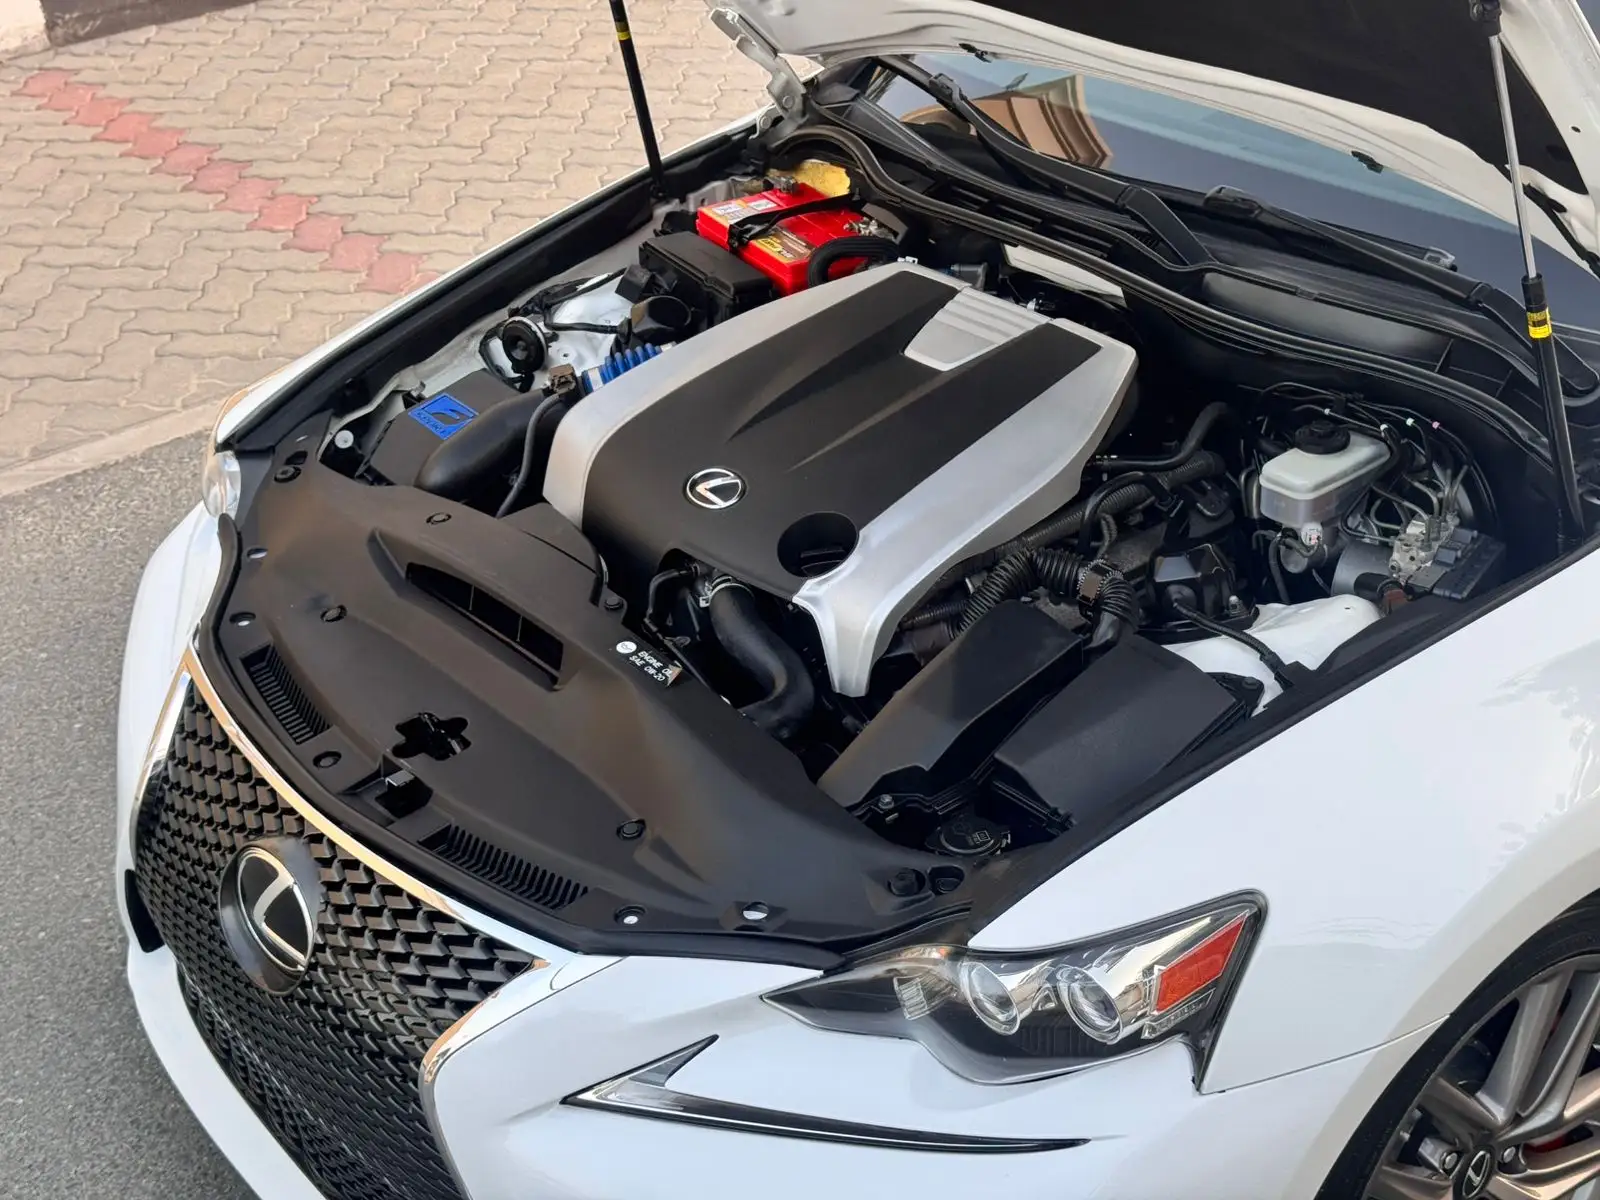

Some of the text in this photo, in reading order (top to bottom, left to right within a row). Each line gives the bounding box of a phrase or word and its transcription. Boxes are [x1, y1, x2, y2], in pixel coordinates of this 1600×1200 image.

[629, 655, 666, 681] SAE 0W-20
[638, 651, 663, 668] ENGINE
